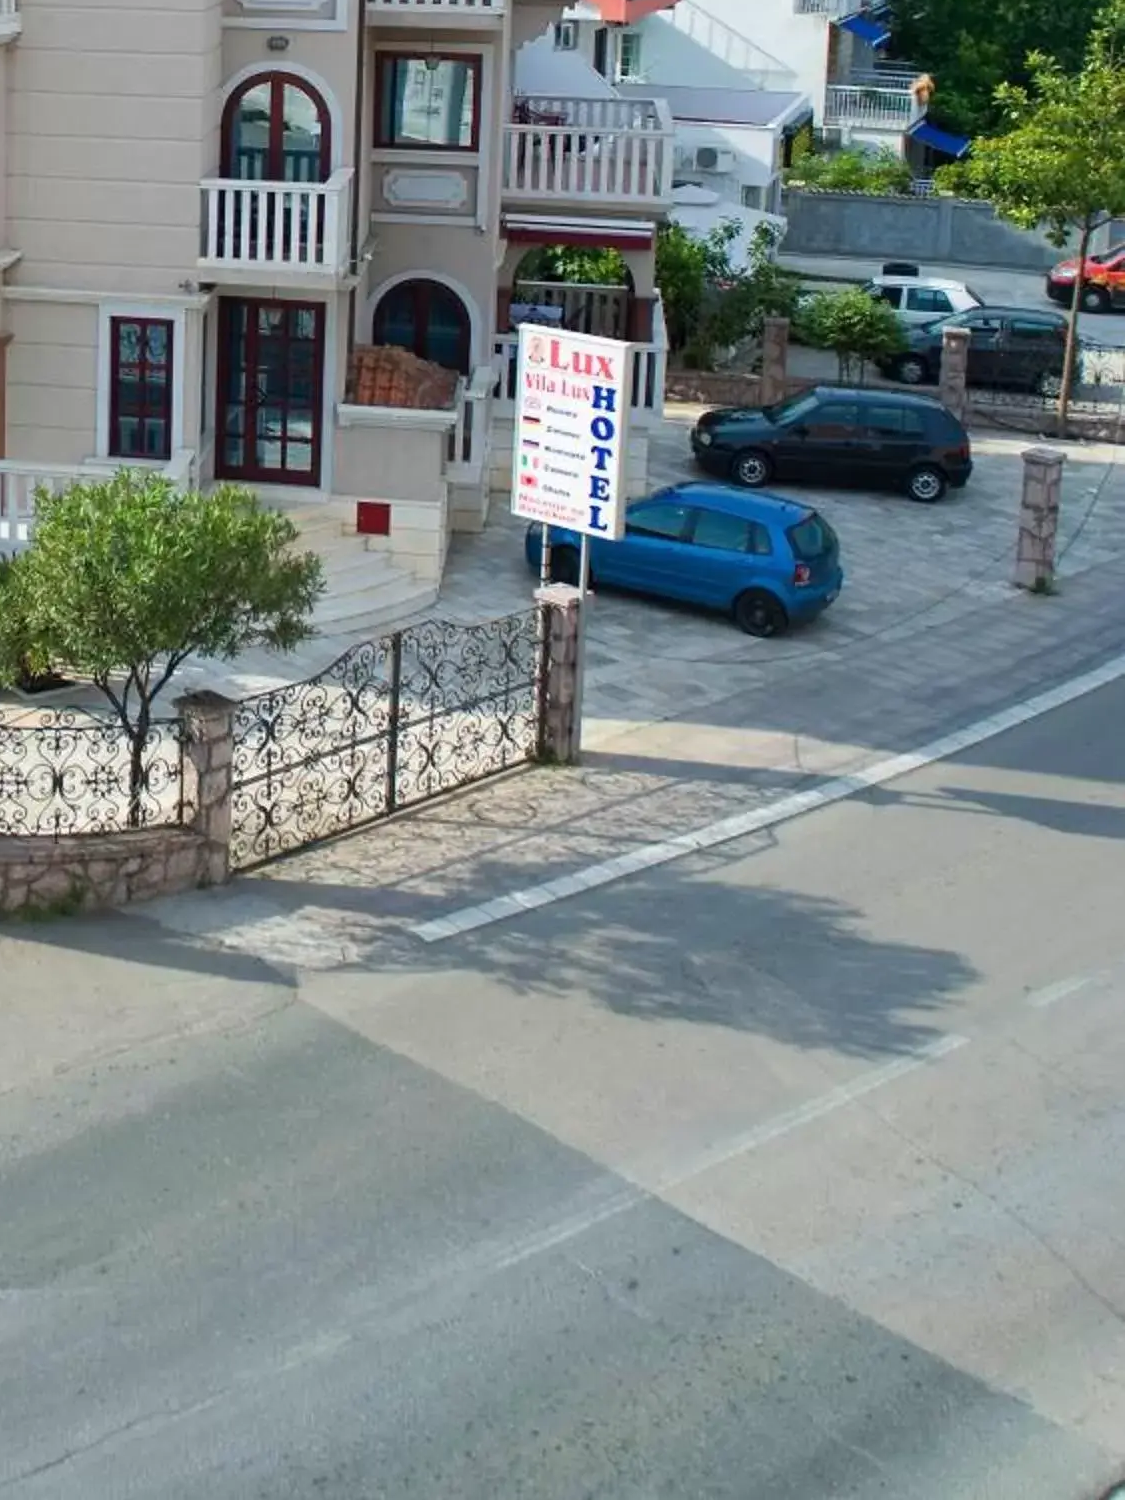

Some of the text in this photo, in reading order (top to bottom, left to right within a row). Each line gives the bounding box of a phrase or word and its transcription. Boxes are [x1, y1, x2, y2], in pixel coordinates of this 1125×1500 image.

[550, 339, 614, 380] Lux
[525, 372, 590, 401] Vila Lux
[588, 385, 617, 532] HOTEL
